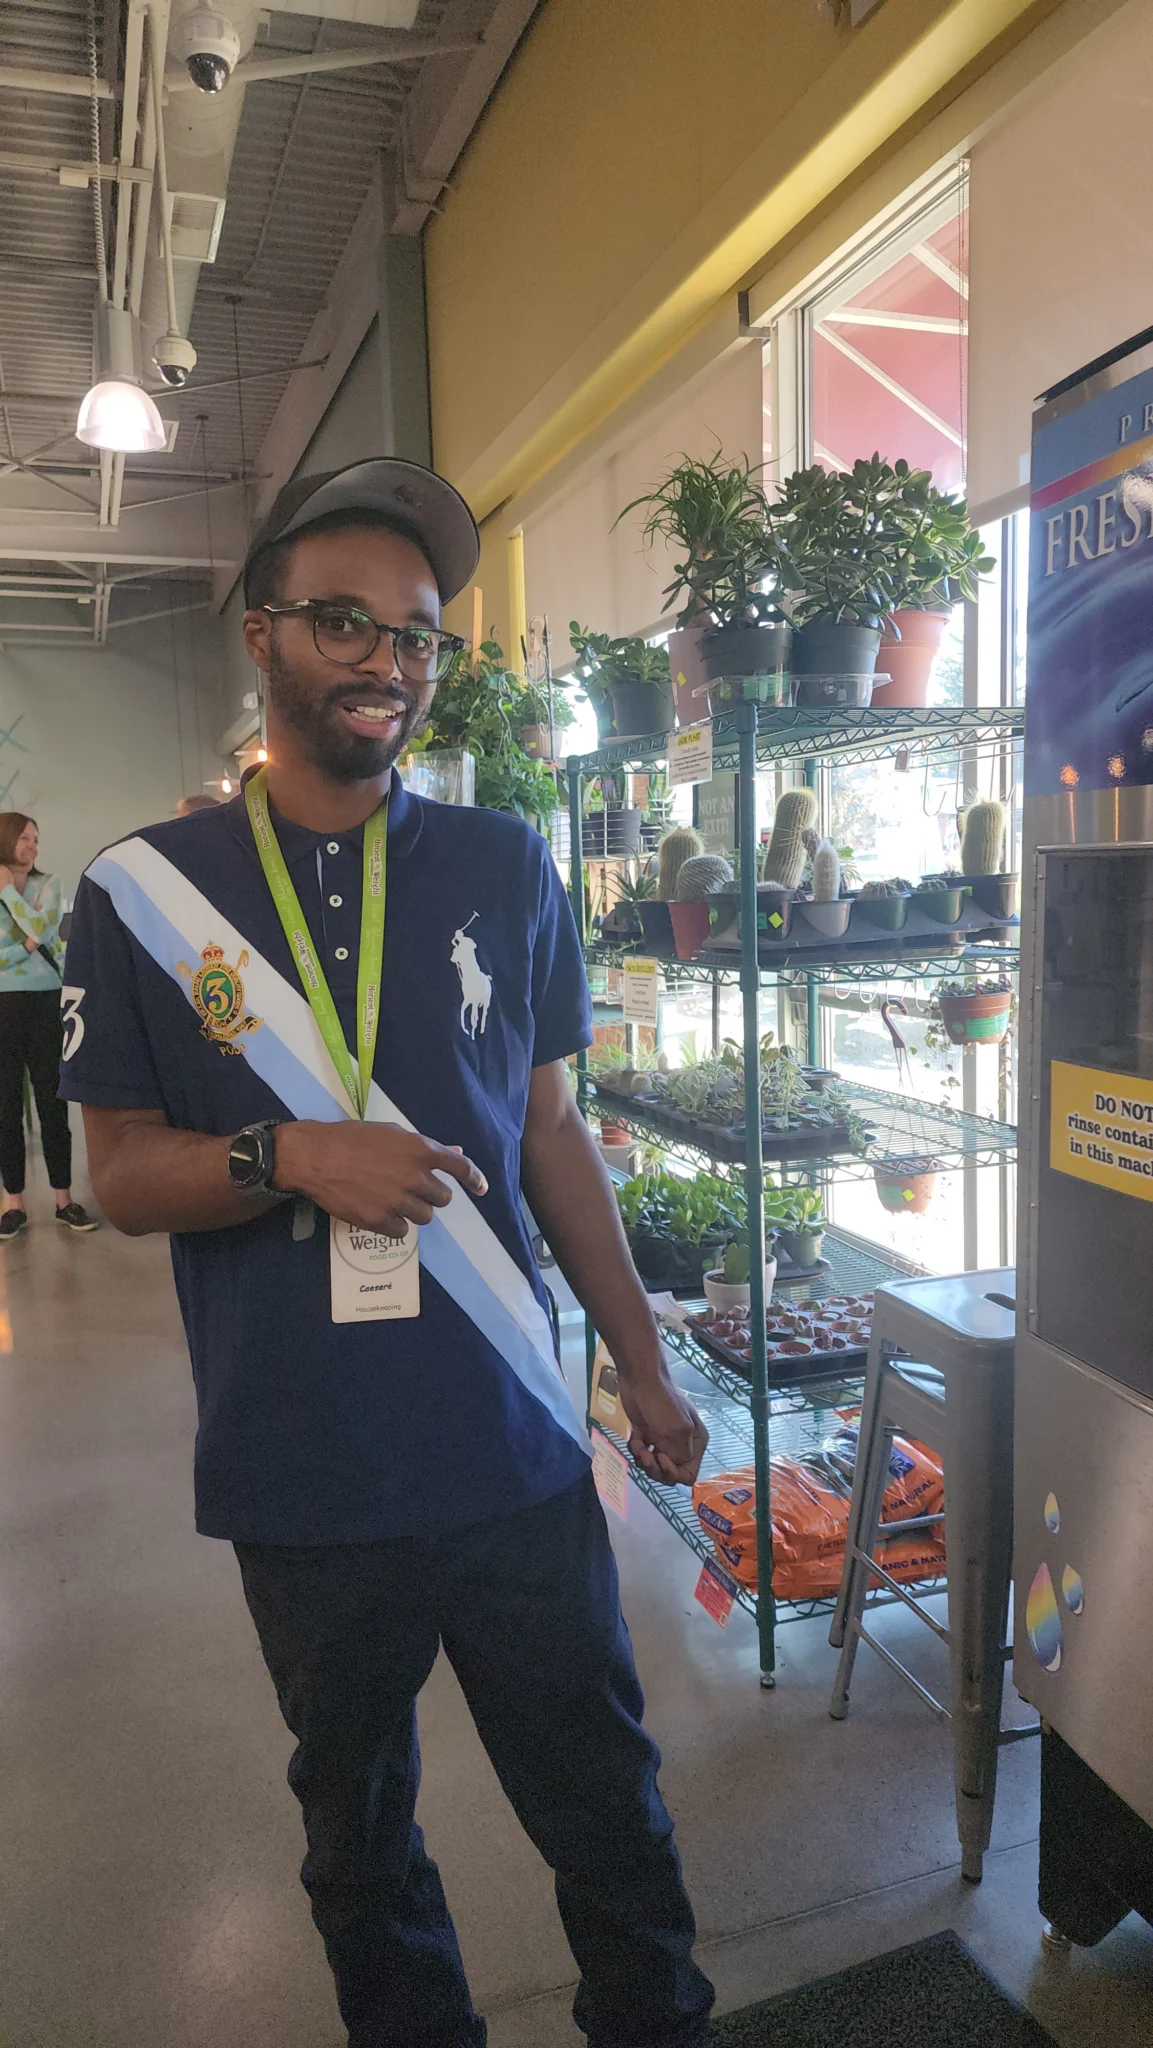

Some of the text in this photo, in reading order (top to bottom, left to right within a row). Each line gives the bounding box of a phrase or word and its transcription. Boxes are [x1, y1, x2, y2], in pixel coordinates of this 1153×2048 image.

[1045, 489, 1153, 577] FRES
[699, 795, 735, 816] NOT AN
[373, 838, 382, 862] Honest
[371, 871, 381, 896] Weight
[292, 930, 306, 956] Weight
[305, 964, 319, 988] Honest
[205, 977, 229, 1015] 3
[367, 985, 376, 1010] Honest
[60, 985, 86, 1062] 3
[365, 1020, 373, 1045] Weight
[1095, 1094, 1153, 1123] DO NOT
[1068, 1114, 1101, 1135] rinse
[1070, 1137, 1083, 1155] in
[1087, 1144, 1114, 1165] this
[370, 1251, 409, 1261] FOOD CO-OP
[356, 1304, 402, 1313] Housekeeping
[881, 1560, 909, 1572] ANIC
[911, 1558, 920, 1568] &
